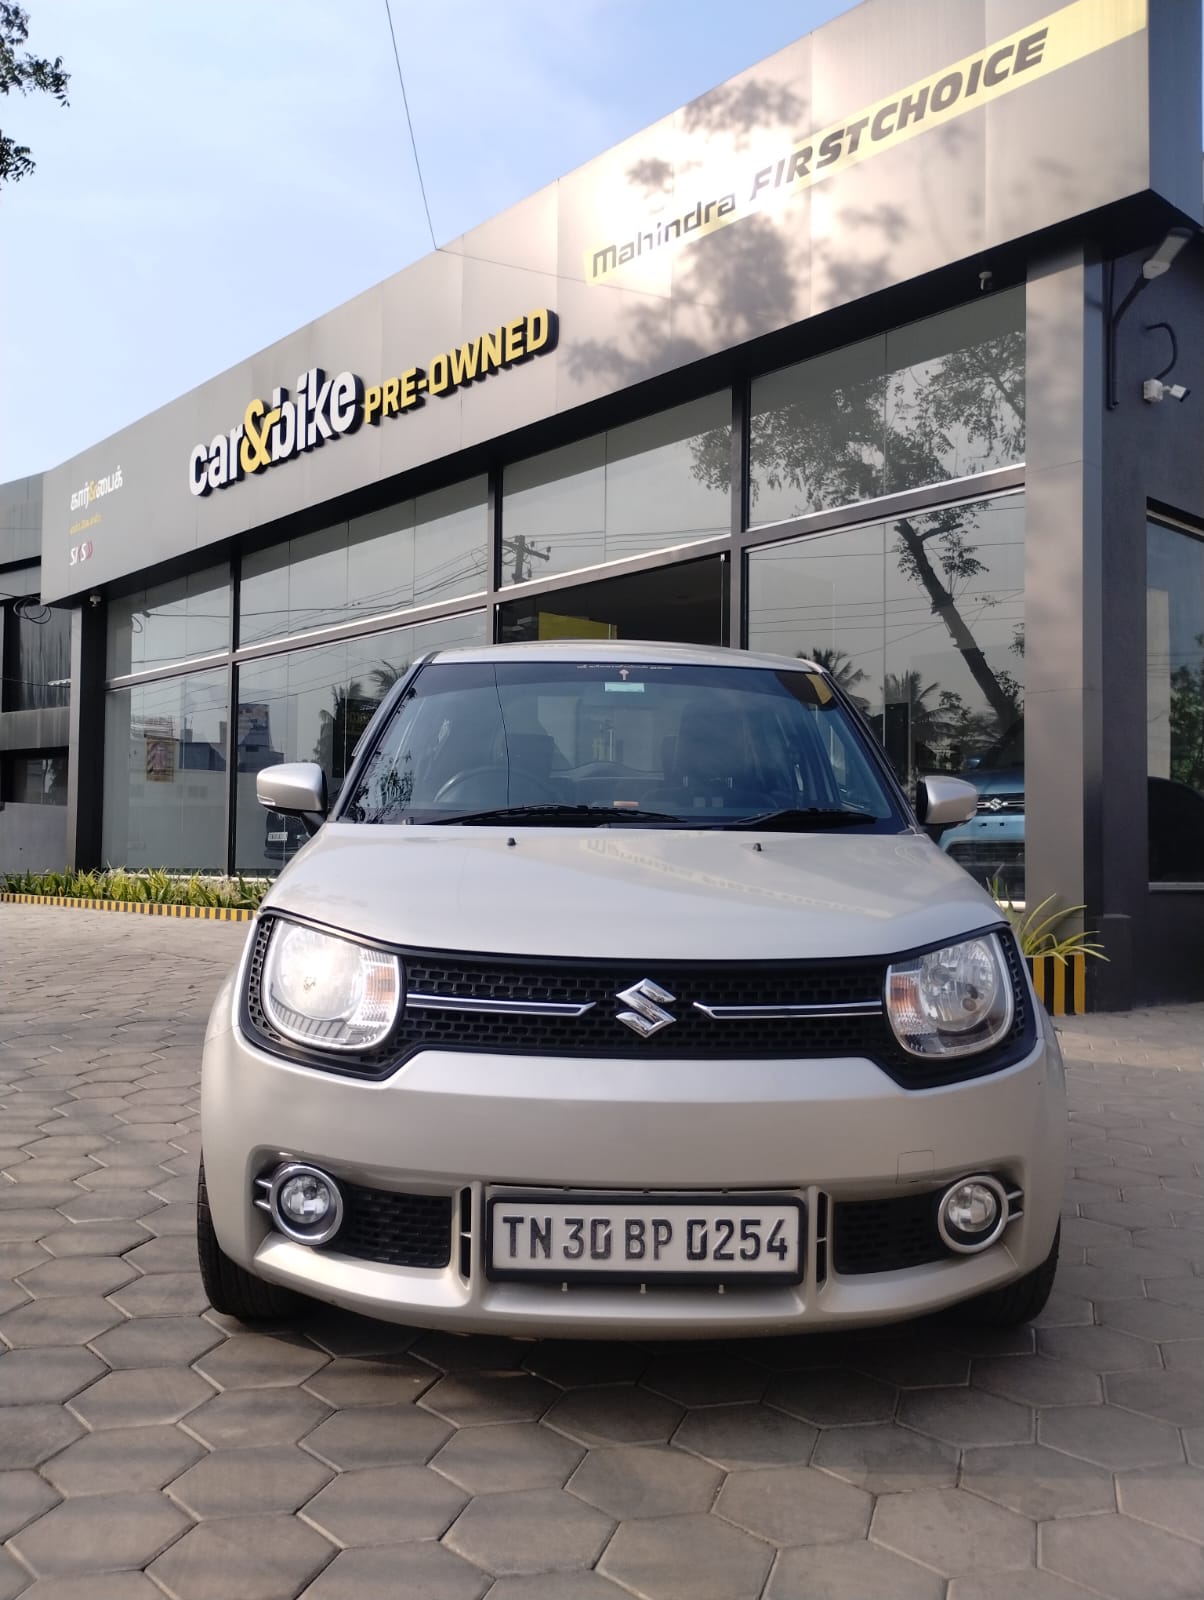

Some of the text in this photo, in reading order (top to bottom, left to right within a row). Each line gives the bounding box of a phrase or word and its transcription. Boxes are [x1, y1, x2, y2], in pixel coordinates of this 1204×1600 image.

[592, 191, 736, 278] Mahindra
[188, 307, 555, 497] car&bike PRE-OWNED
[502, 1215, 789, 1262] TN 30 BP 0254
